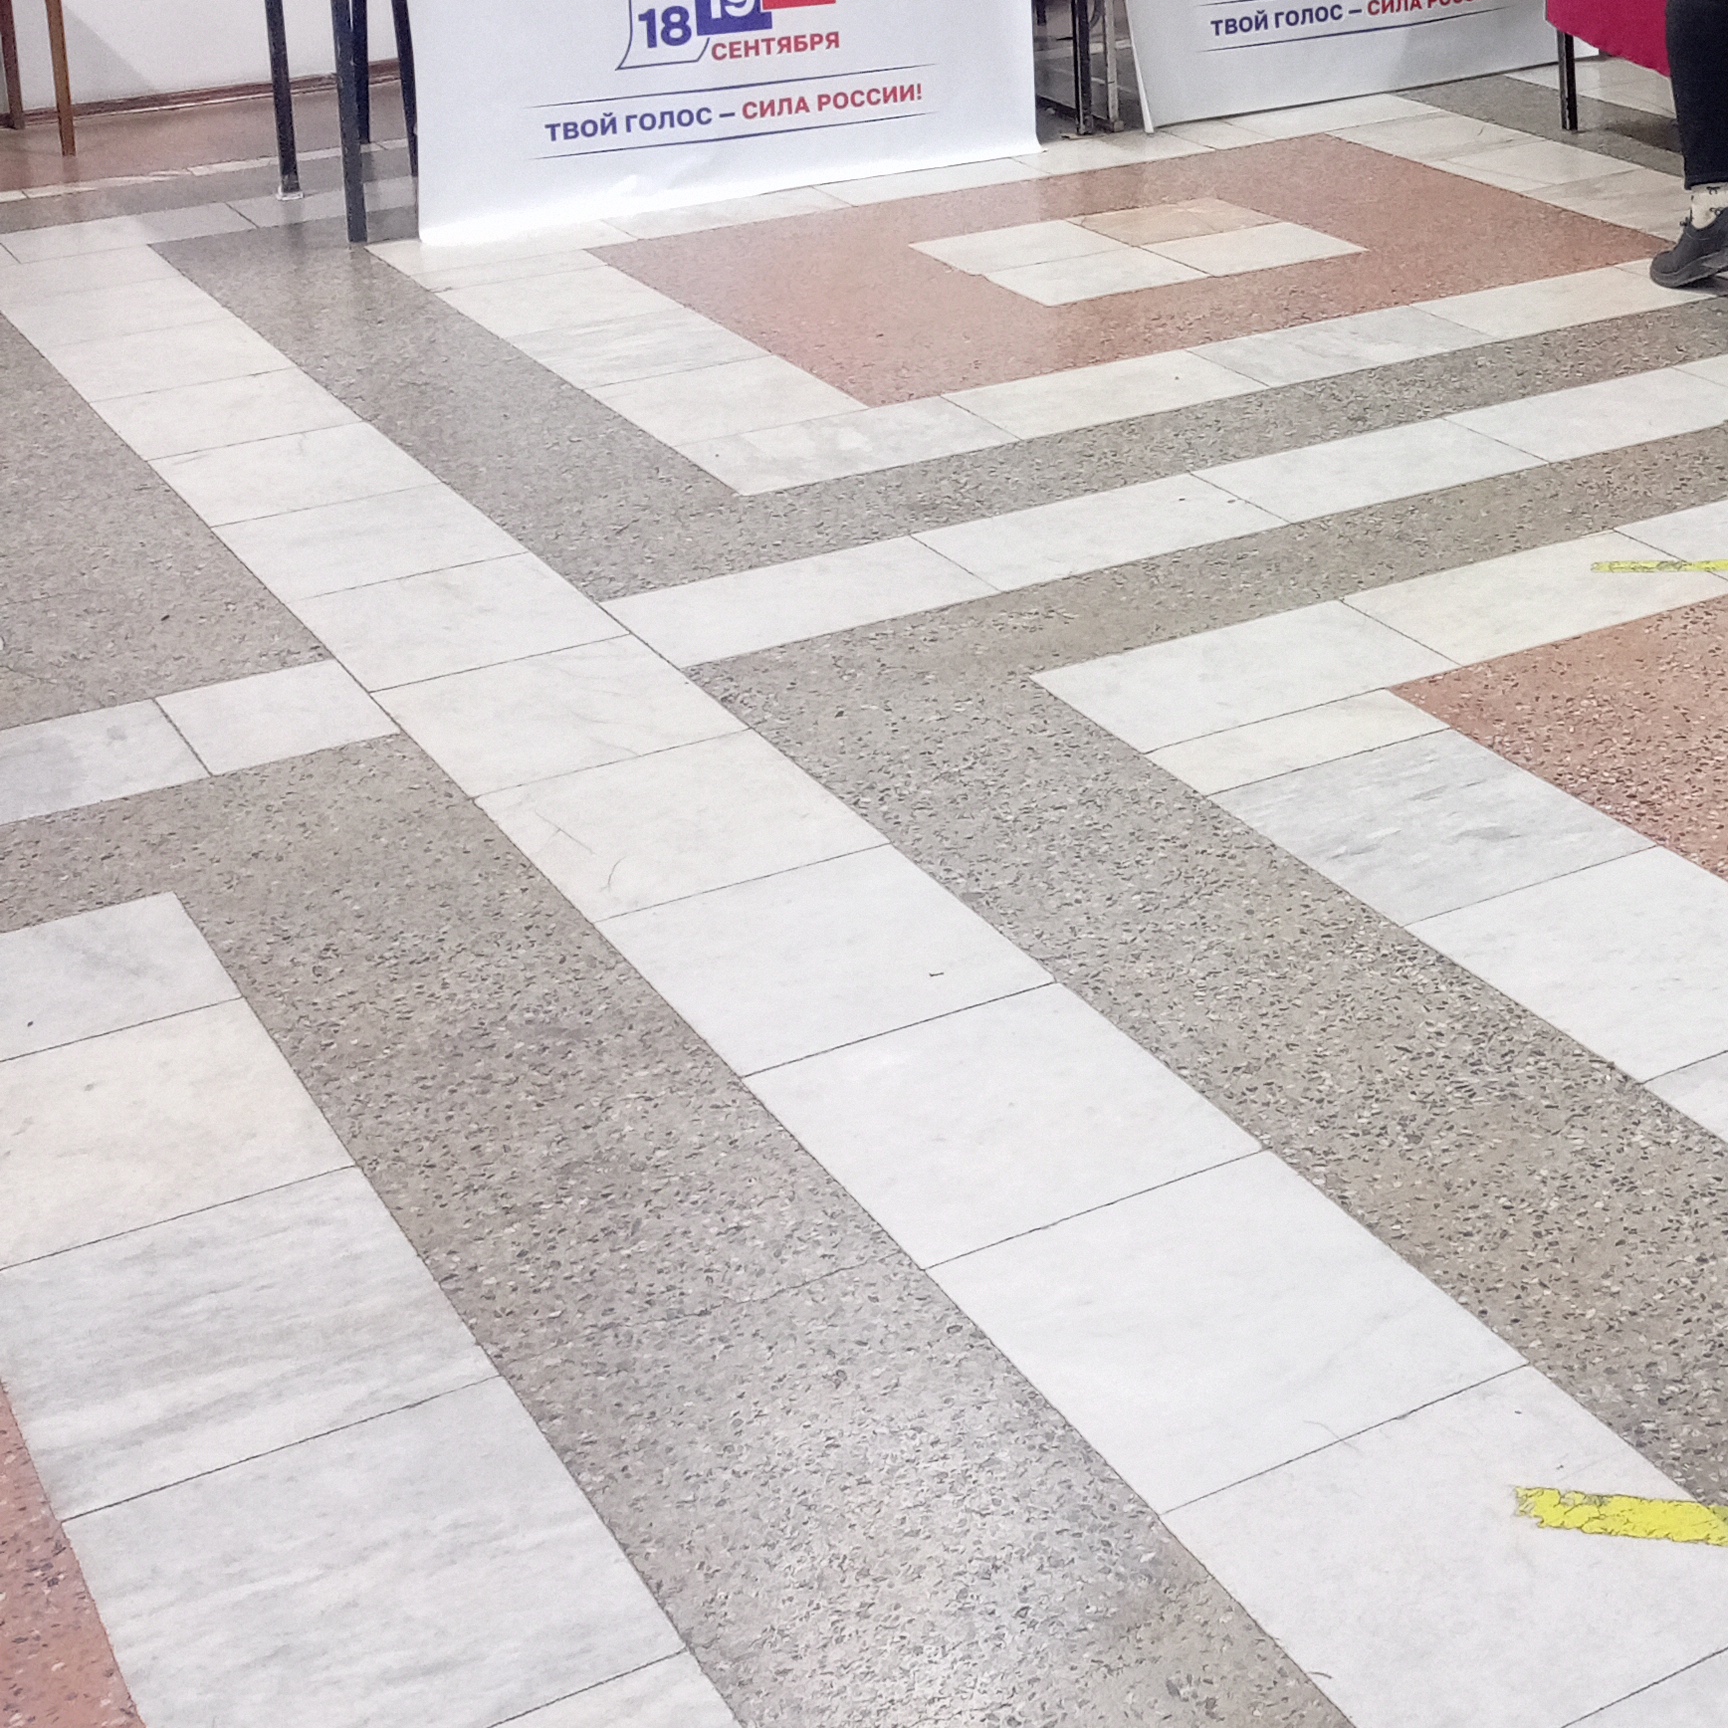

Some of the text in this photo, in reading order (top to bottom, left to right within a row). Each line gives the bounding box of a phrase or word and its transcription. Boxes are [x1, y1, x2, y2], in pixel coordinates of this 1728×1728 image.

[638, 5, 692, 48] 18
[1210, 10, 1268, 36] ТВОЙ
[1274, 4, 1343, 29] ГОЛОС
[711, 31, 840, 61] СЕНТЯБРЯ
[545, 113, 618, 142] ТВОЙ
[625, 107, 712, 133] ГОЛОС
[742, 95, 808, 120] СИЛА
[817, 83, 922, 112] РОССИИ!
